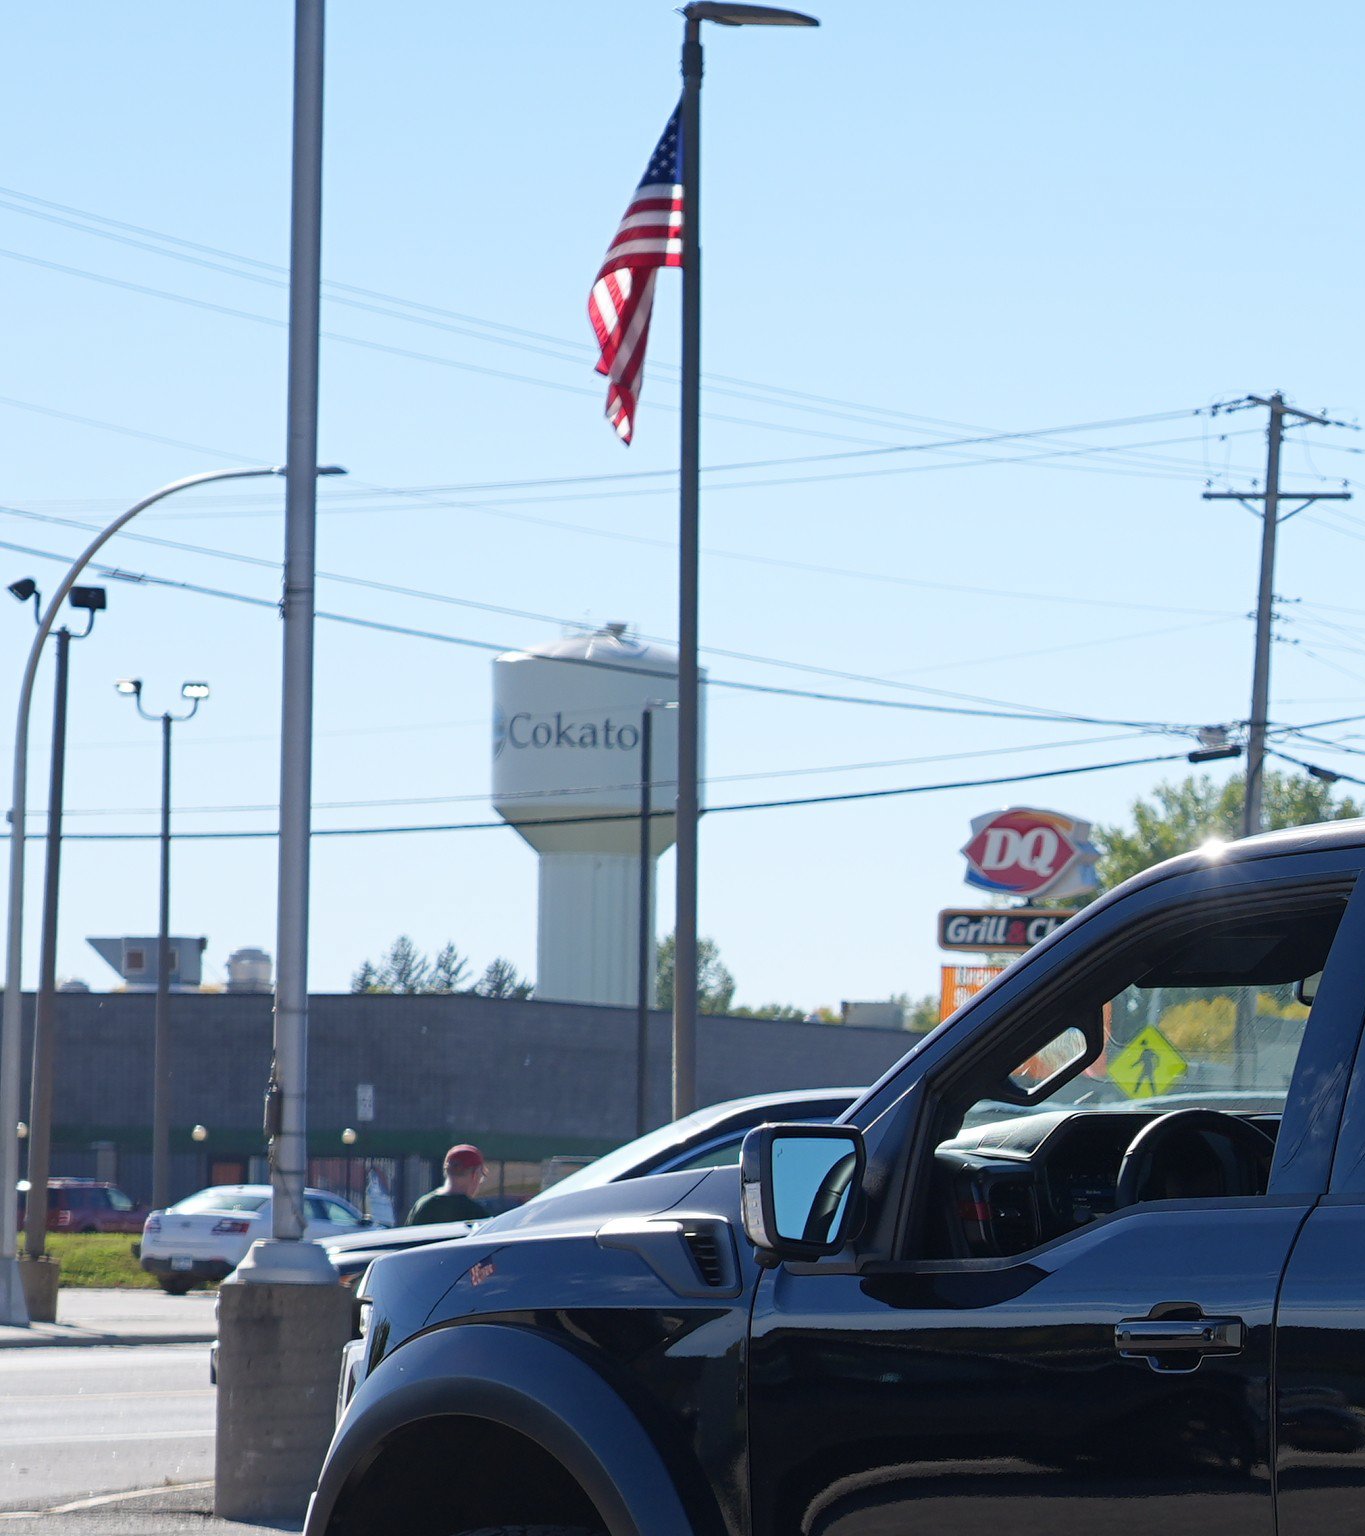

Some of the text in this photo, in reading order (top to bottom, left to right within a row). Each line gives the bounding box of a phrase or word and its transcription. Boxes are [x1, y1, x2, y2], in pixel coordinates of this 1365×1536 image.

[509, 711, 640, 751] Cokato
[981, 827, 1058, 877] DQ
[948, 915, 1008, 944] Grill
[1008, 920, 1028, 944] &
